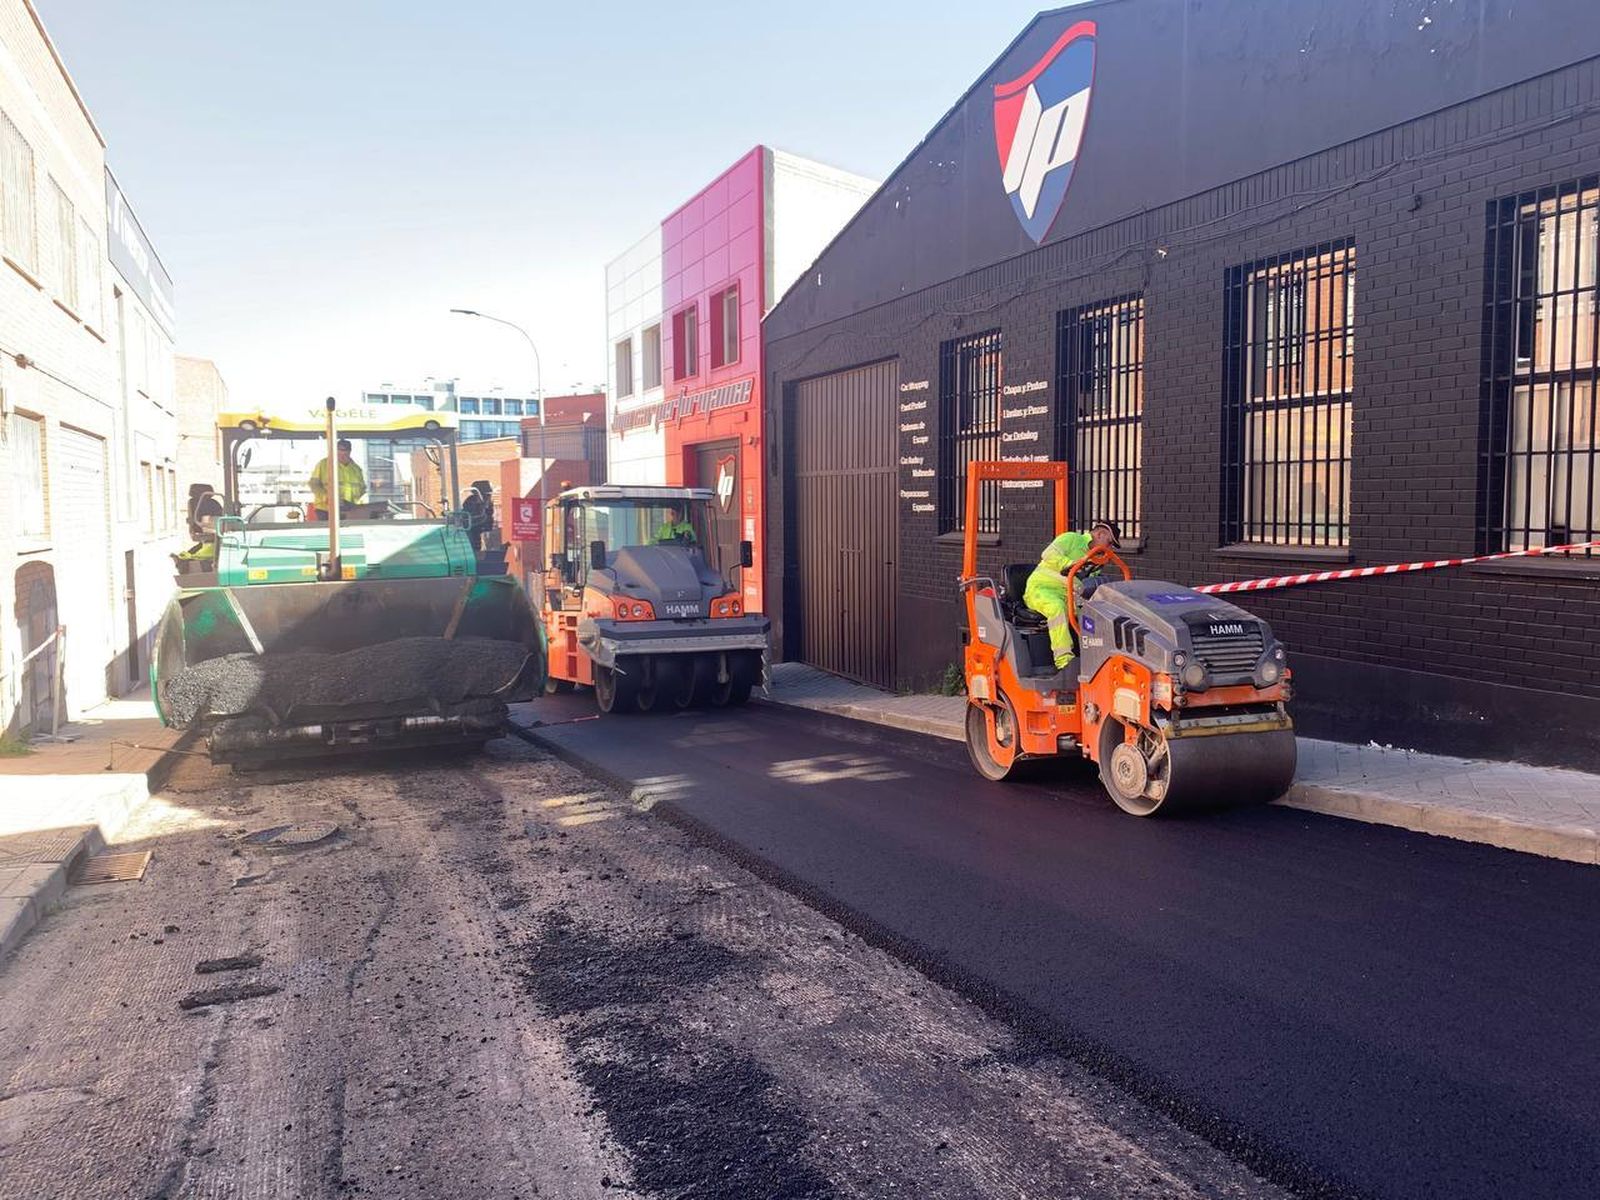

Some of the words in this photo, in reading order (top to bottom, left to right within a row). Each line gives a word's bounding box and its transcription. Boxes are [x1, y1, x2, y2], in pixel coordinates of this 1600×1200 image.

[308, 409, 377, 419] VGELE
[665, 604, 700, 614] HAMM
[1210, 624, 1244, 635] HAMM
